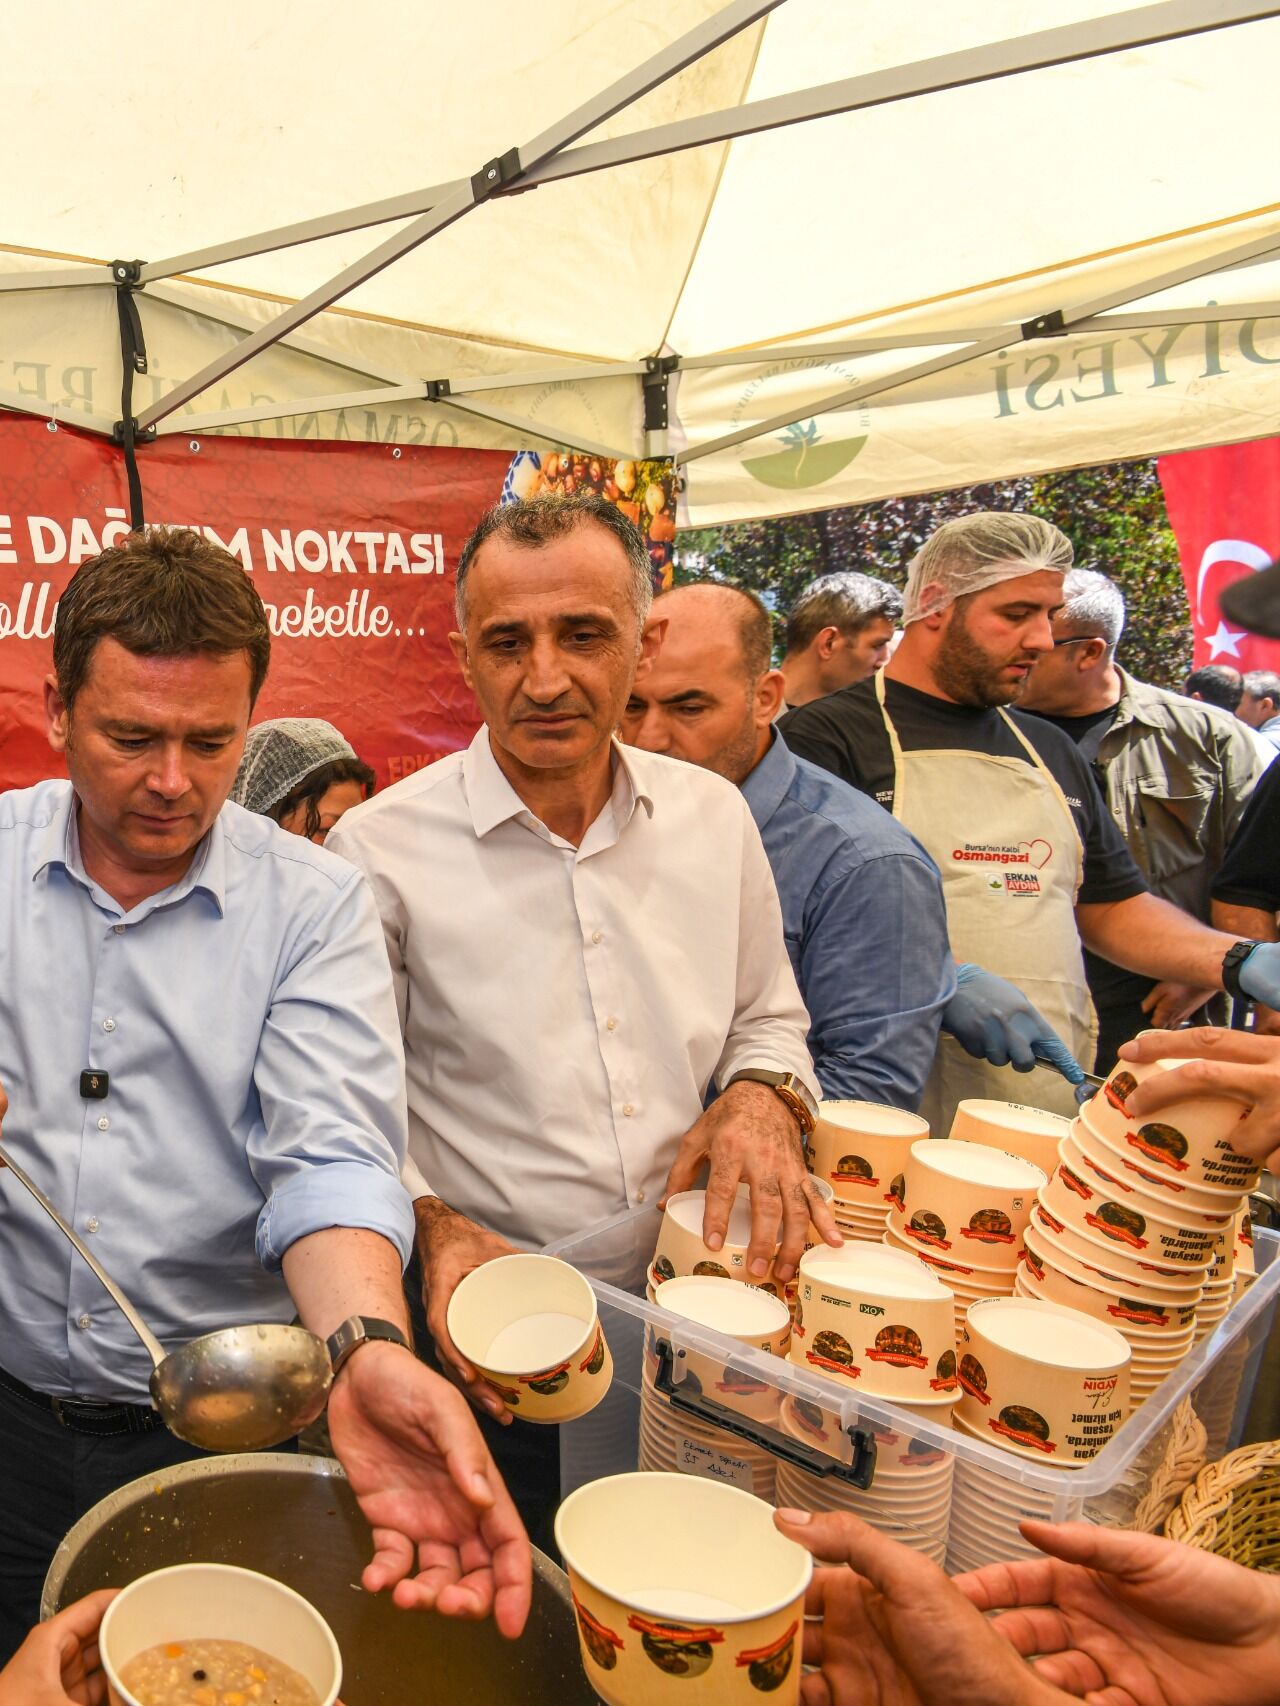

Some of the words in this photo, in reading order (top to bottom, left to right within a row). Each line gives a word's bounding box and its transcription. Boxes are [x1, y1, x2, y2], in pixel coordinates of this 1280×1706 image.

[26, 507, 254, 572] DAĞM
[261, 527, 445, 575] NOKTASI
[1001, 845, 1020, 854] Kalbi
[952, 850, 1029, 864] Osmangazi
[1005, 872, 1038, 882] ERKAN
[1008, 881, 1039, 891] AYDIN
[1083, 1379, 1118, 1390] AYDIN
[1071, 1413, 1107, 1425] Hizmet
[1082, 1424, 1114, 1435] Yaşam
